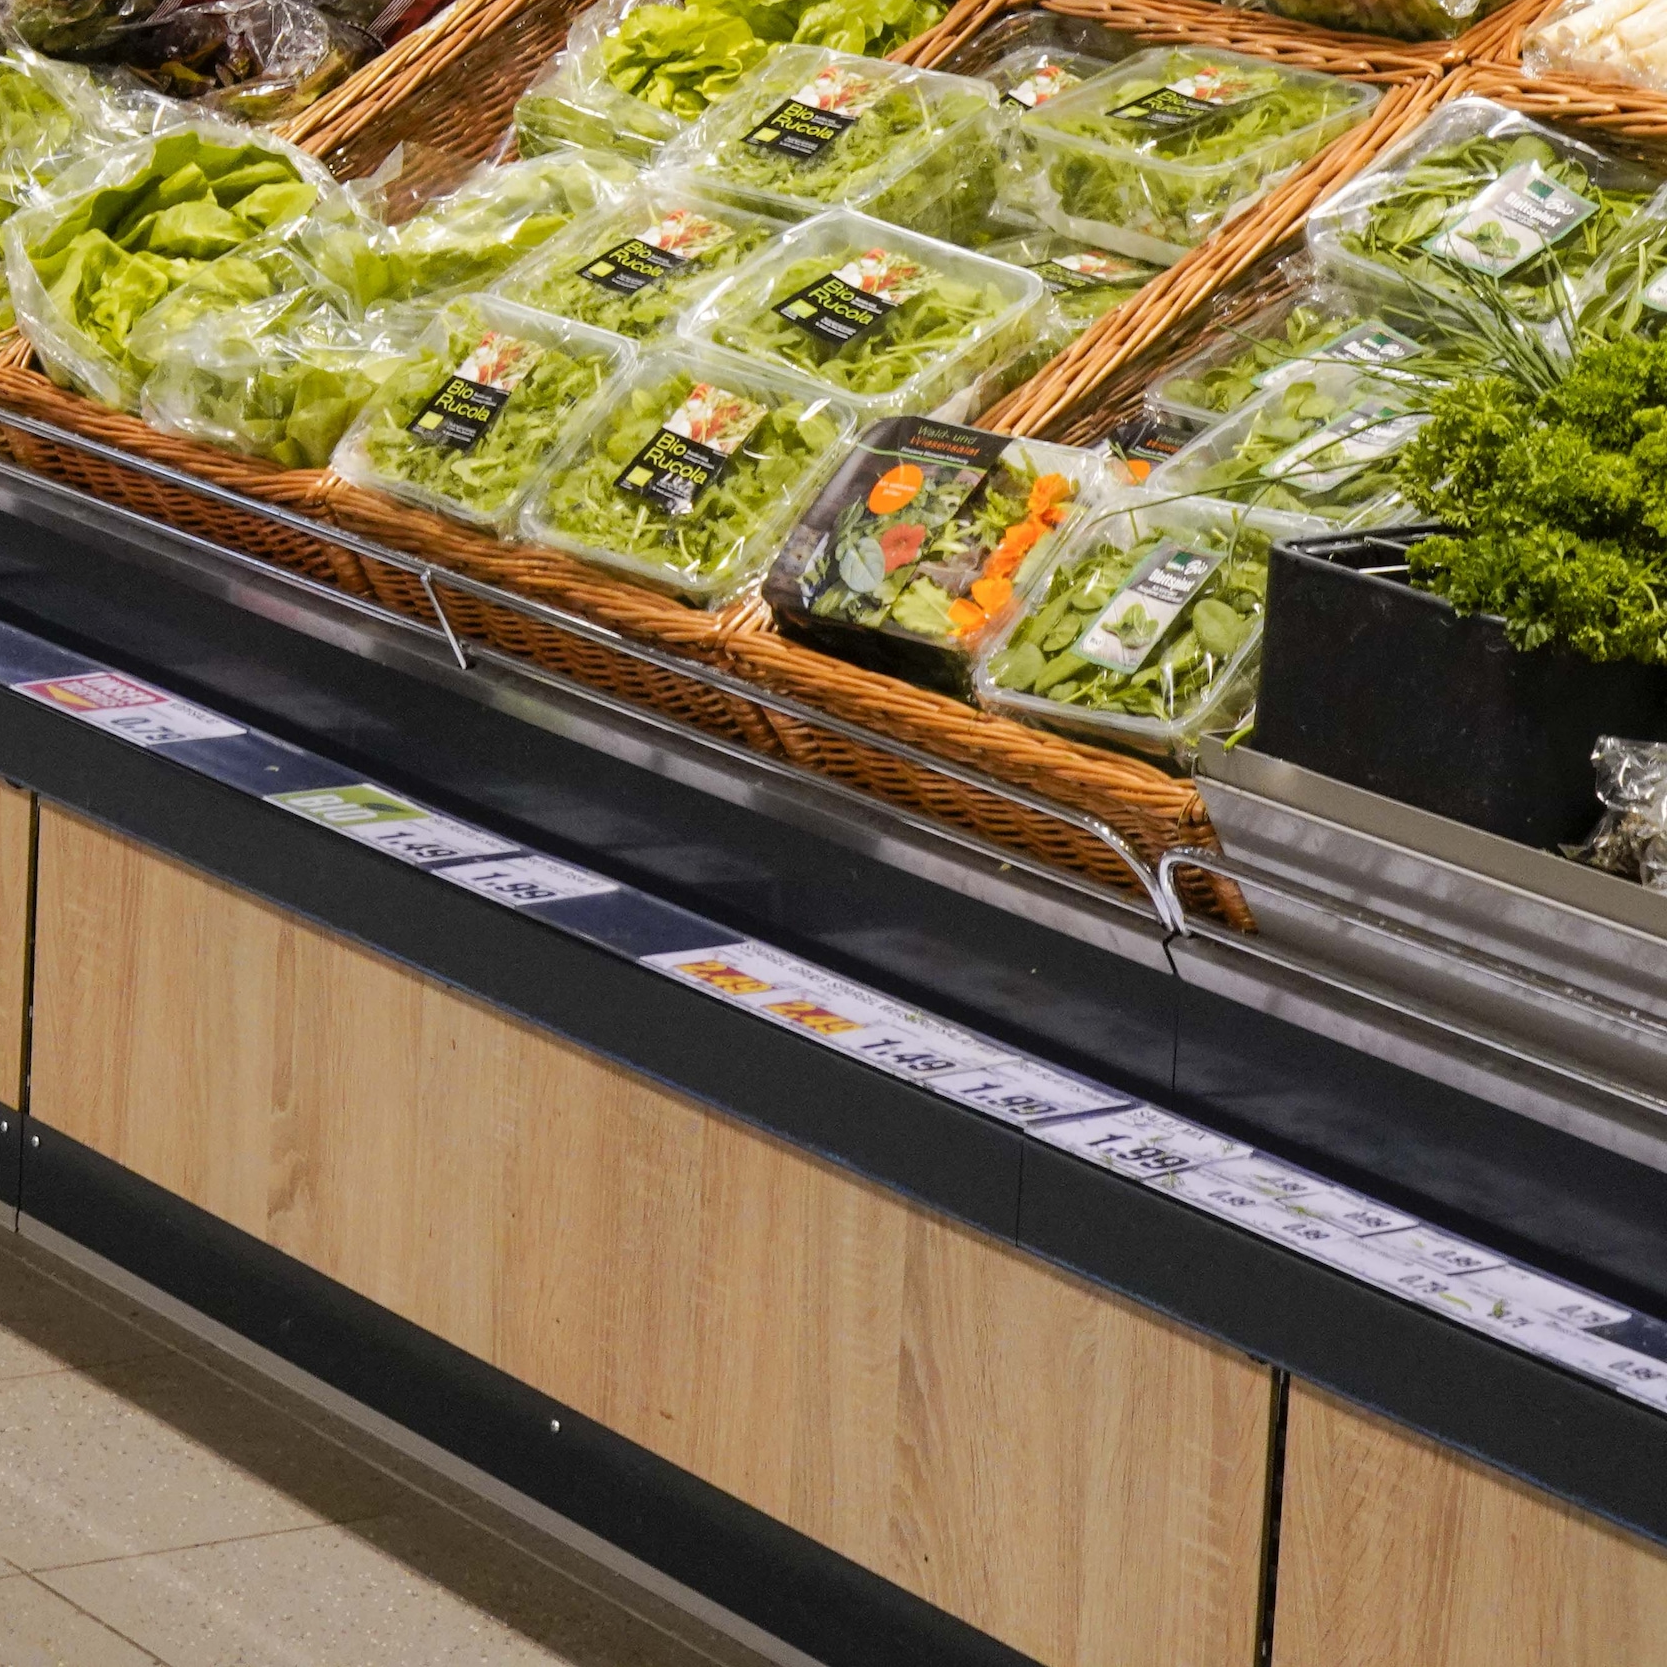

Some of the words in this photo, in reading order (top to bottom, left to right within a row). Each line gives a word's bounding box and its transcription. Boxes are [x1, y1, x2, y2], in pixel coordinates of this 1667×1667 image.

[784, 103, 814, 121] Bio
[771, 113, 834, 140] Rucola
[1504, 191, 1560, 227] Blattspinat
[608, 249, 664, 277] Rucola
[624, 241, 652, 259] Bio
[823, 278, 855, 301] Bio
[808, 287, 874, 325] Rucola
[447, 378, 474, 399] Bio
[434, 392, 490, 422] Rucola
[656, 432, 687, 456] Bio
[910, 436, 981, 457] Wiesensalat
[918, 426, 949, 439] Wald-
[953, 433, 977, 445] und
[643, 446, 708, 485] Rucola
[1148, 567, 1196, 592] Blattspinat
[110, 717, 186, 741] 0.79
[287, 794, 378, 822] BIO
[376, 832, 458, 858] 1.49
[471, 873, 555, 899] 1.99
[672, 960, 775, 995] 2.49
[760, 1000, 864, 1036] 2.49
[860, 1038, 956, 1070] 1.49
[960, 1083, 1057, 1114] 1.99
[1086, 1134, 1189, 1169] 1.99
